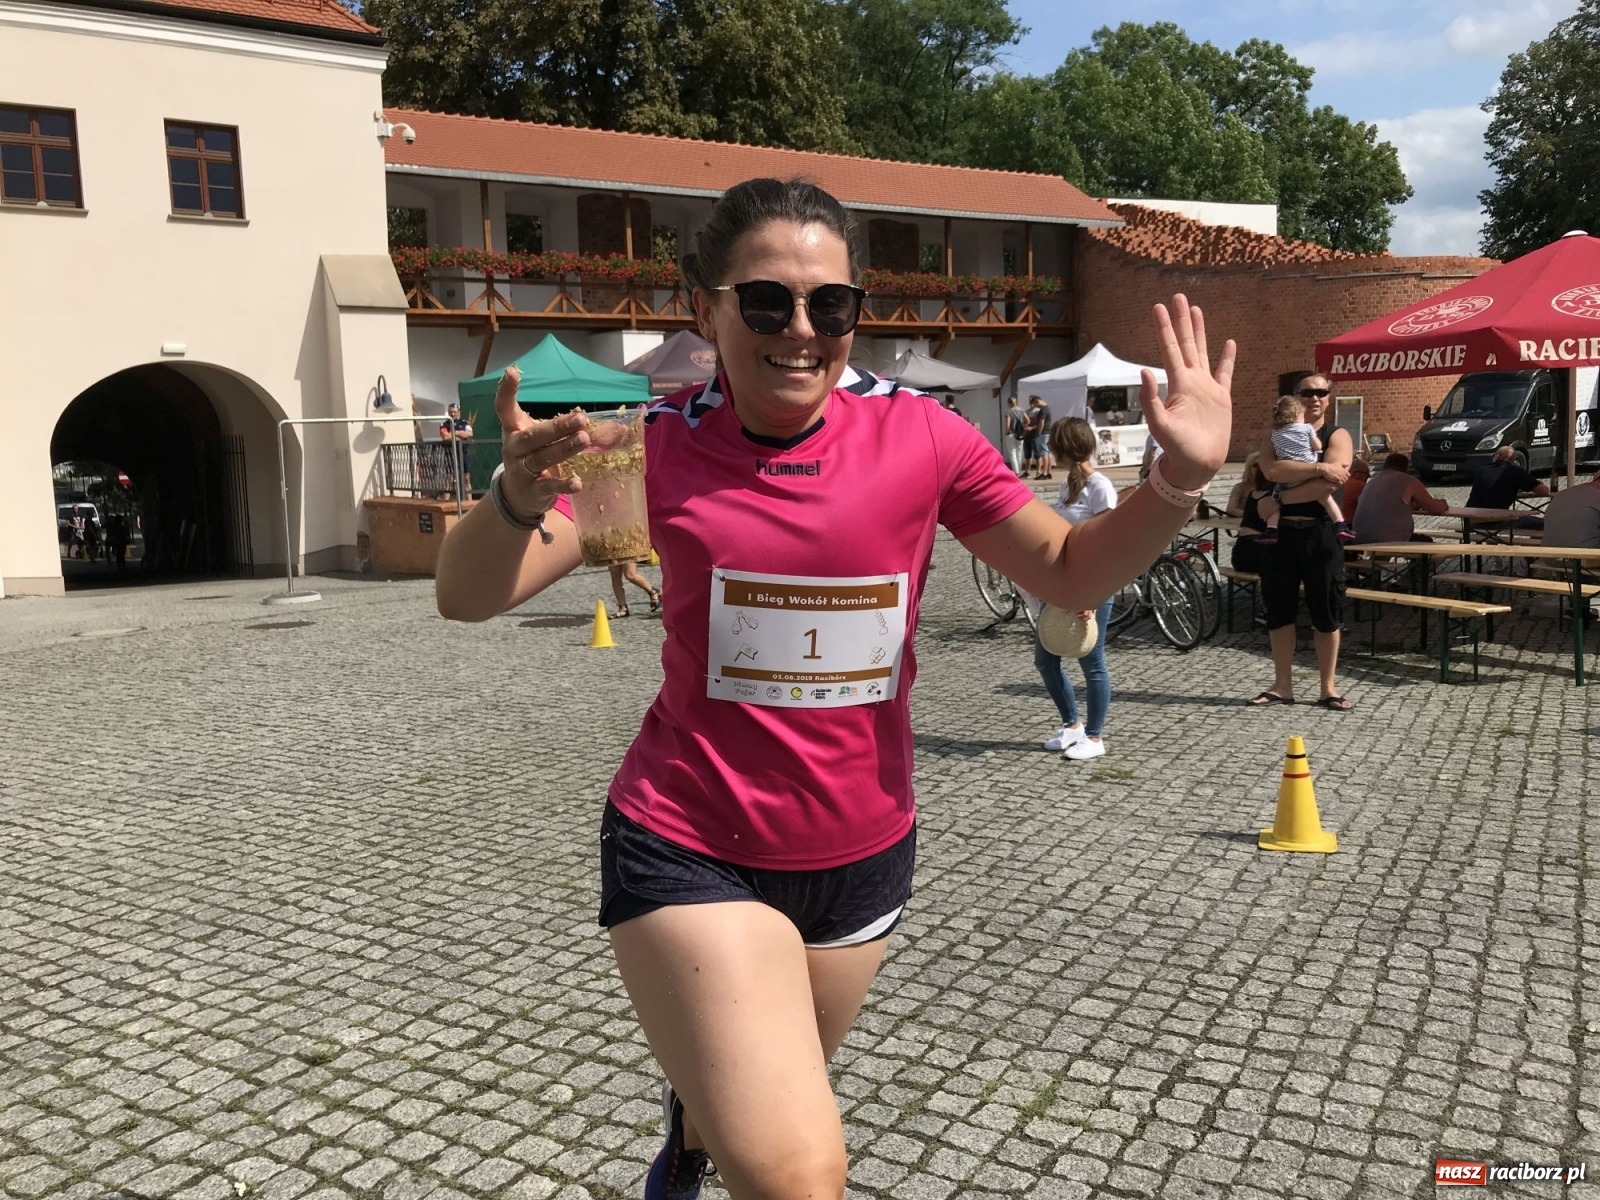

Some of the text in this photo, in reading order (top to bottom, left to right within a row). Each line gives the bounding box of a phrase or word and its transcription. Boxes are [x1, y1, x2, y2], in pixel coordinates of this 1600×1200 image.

[1330, 345, 1467, 374] RACIBORSKIE
[755, 459, 820, 476] hummel
[747, 593, 878, 605] I Bieg Wokół Komina
[802, 628, 822, 660] 1
